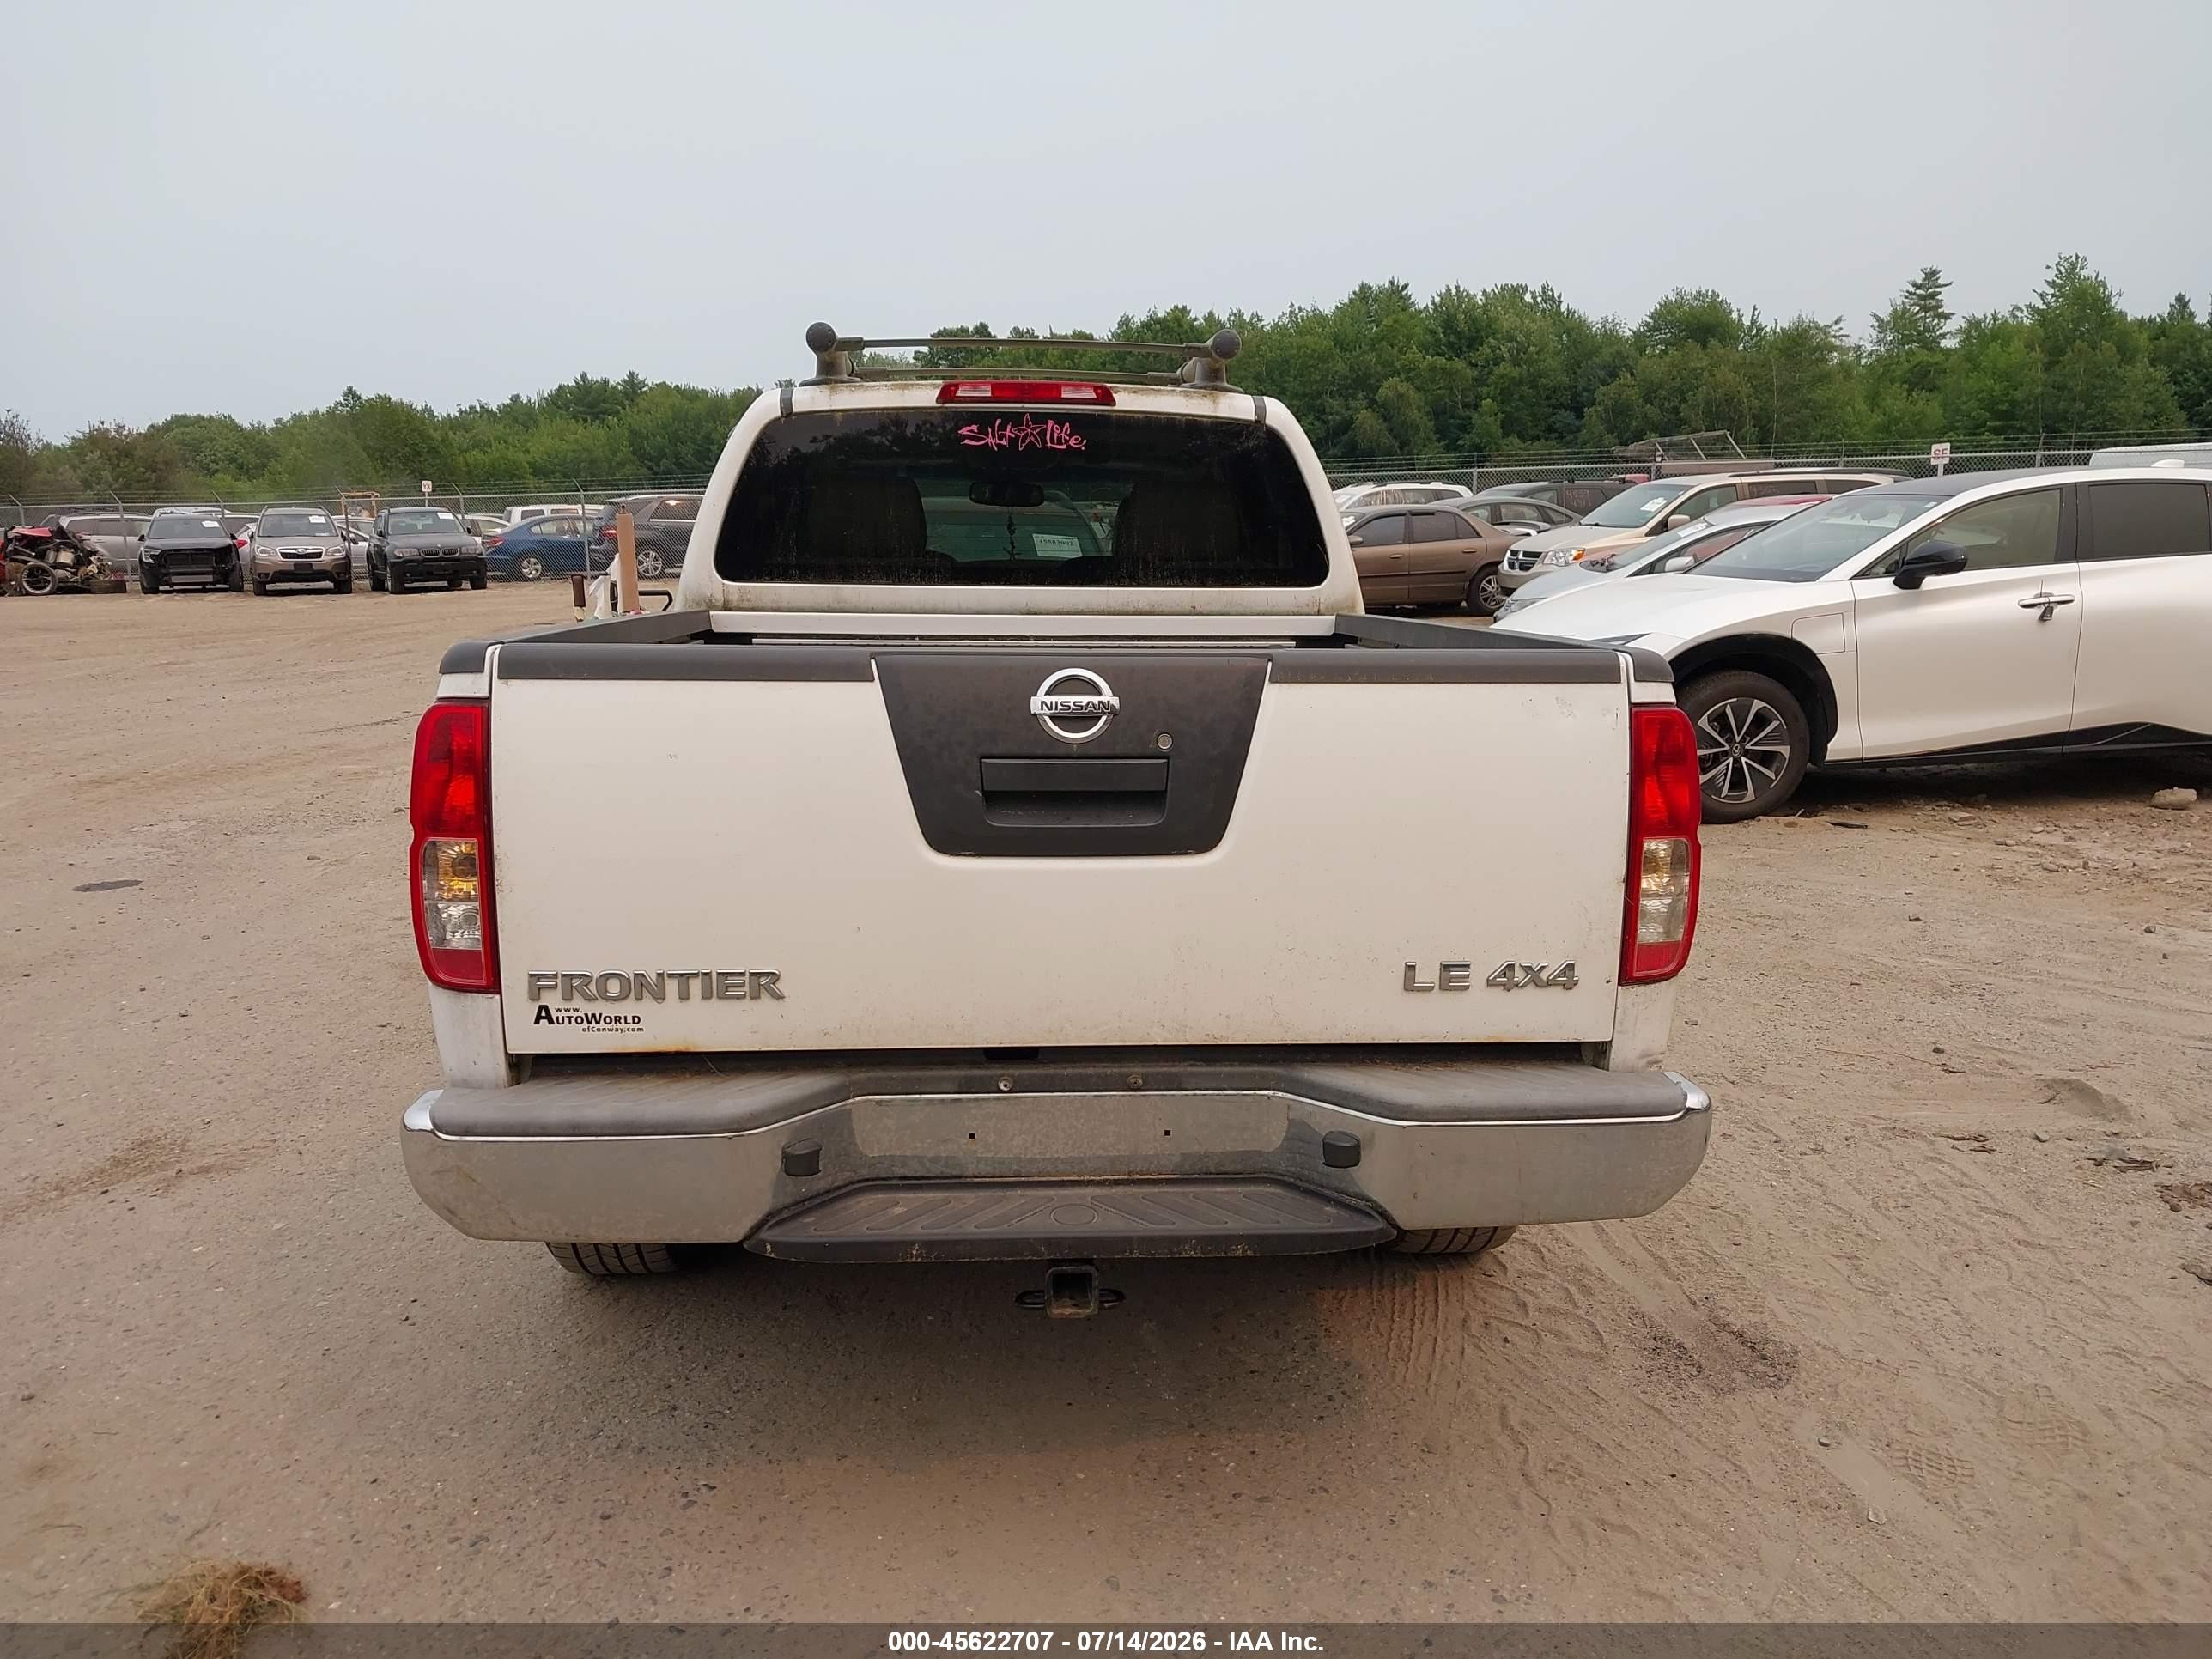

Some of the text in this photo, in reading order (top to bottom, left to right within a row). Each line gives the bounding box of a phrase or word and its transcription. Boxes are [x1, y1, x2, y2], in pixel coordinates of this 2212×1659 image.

[1040, 700, 1111, 713] NISSAN
[527, 969, 786, 1003] FRONTIER
[1403, 960, 1471, 992] LE
